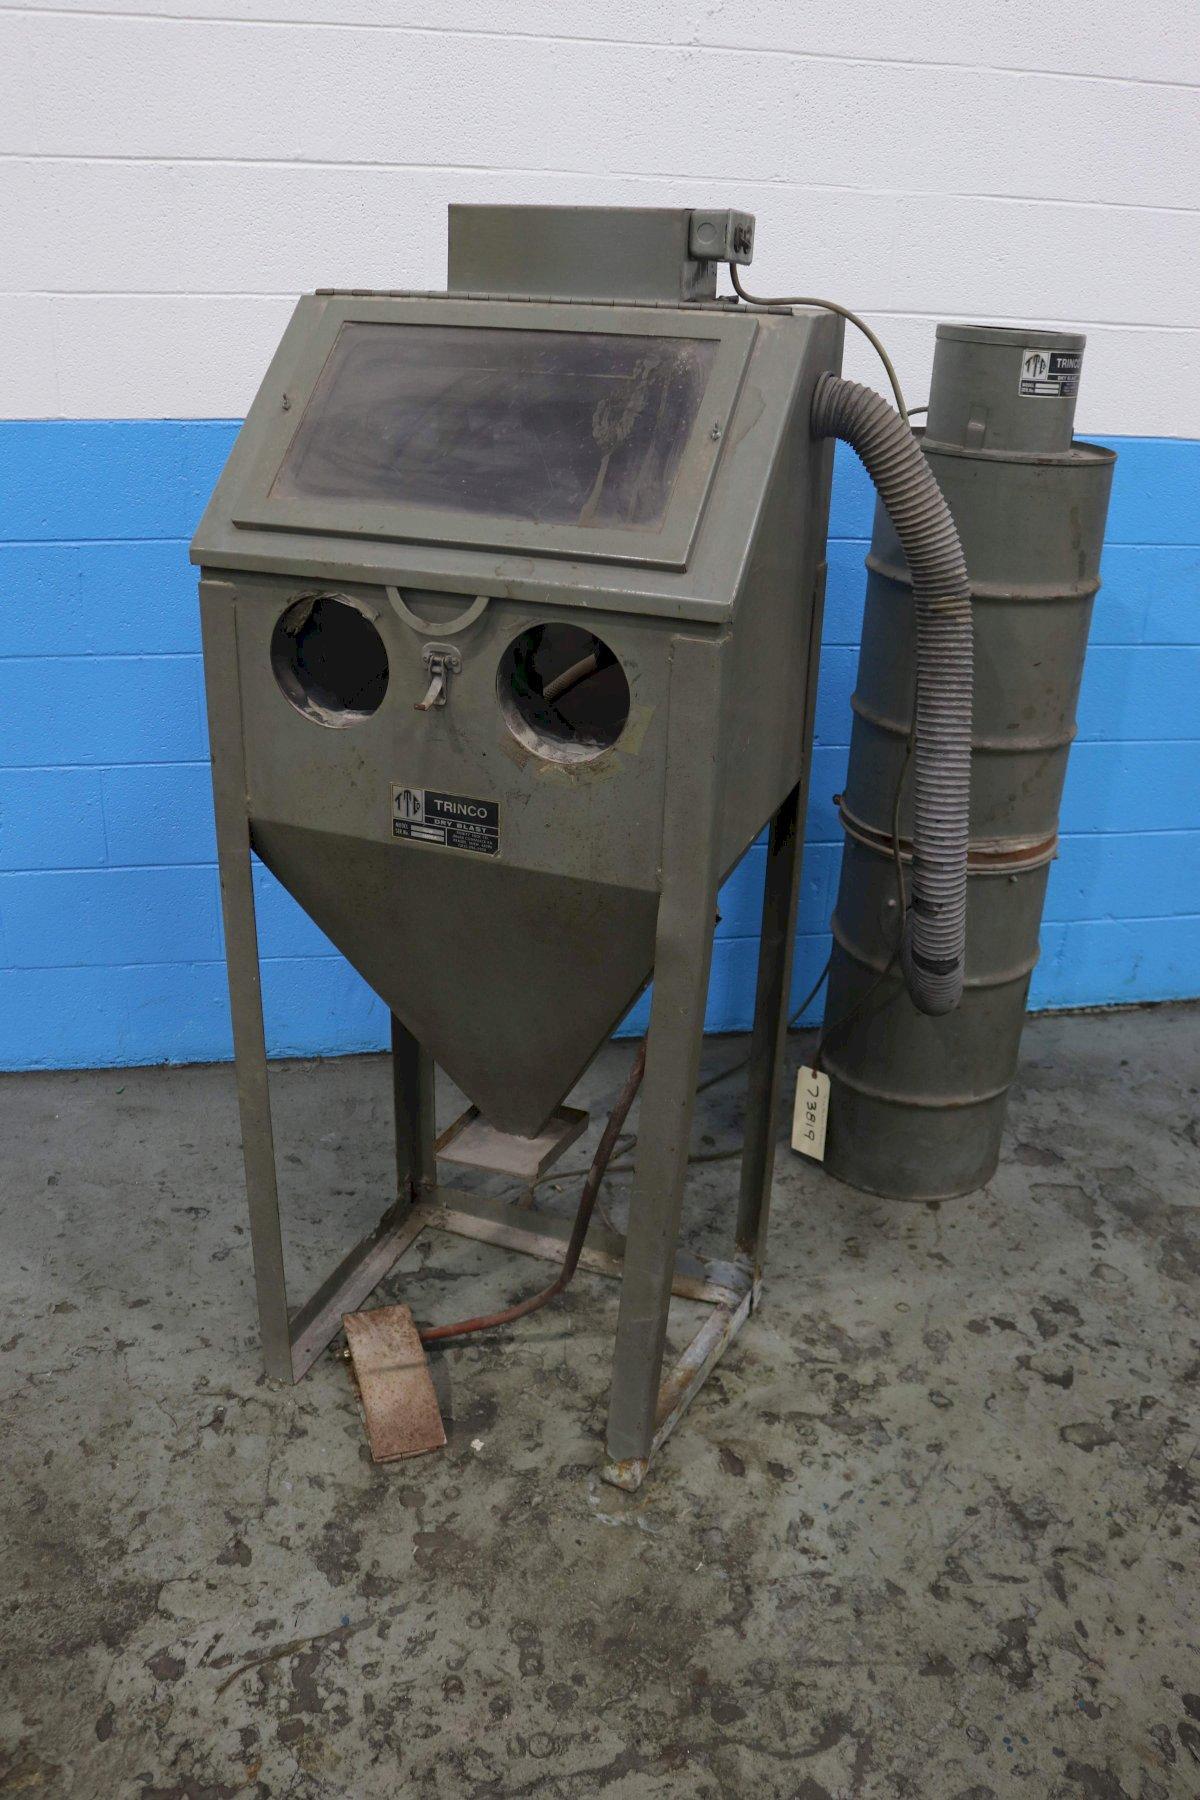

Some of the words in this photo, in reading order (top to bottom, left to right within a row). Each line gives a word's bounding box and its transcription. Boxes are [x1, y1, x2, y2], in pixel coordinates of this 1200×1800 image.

[433, 799, 488, 819] TRINCO
[434, 819, 453, 827] DRY
[456, 823, 487, 834] BLAST
[804, 1085, 819, 1141] 73819
